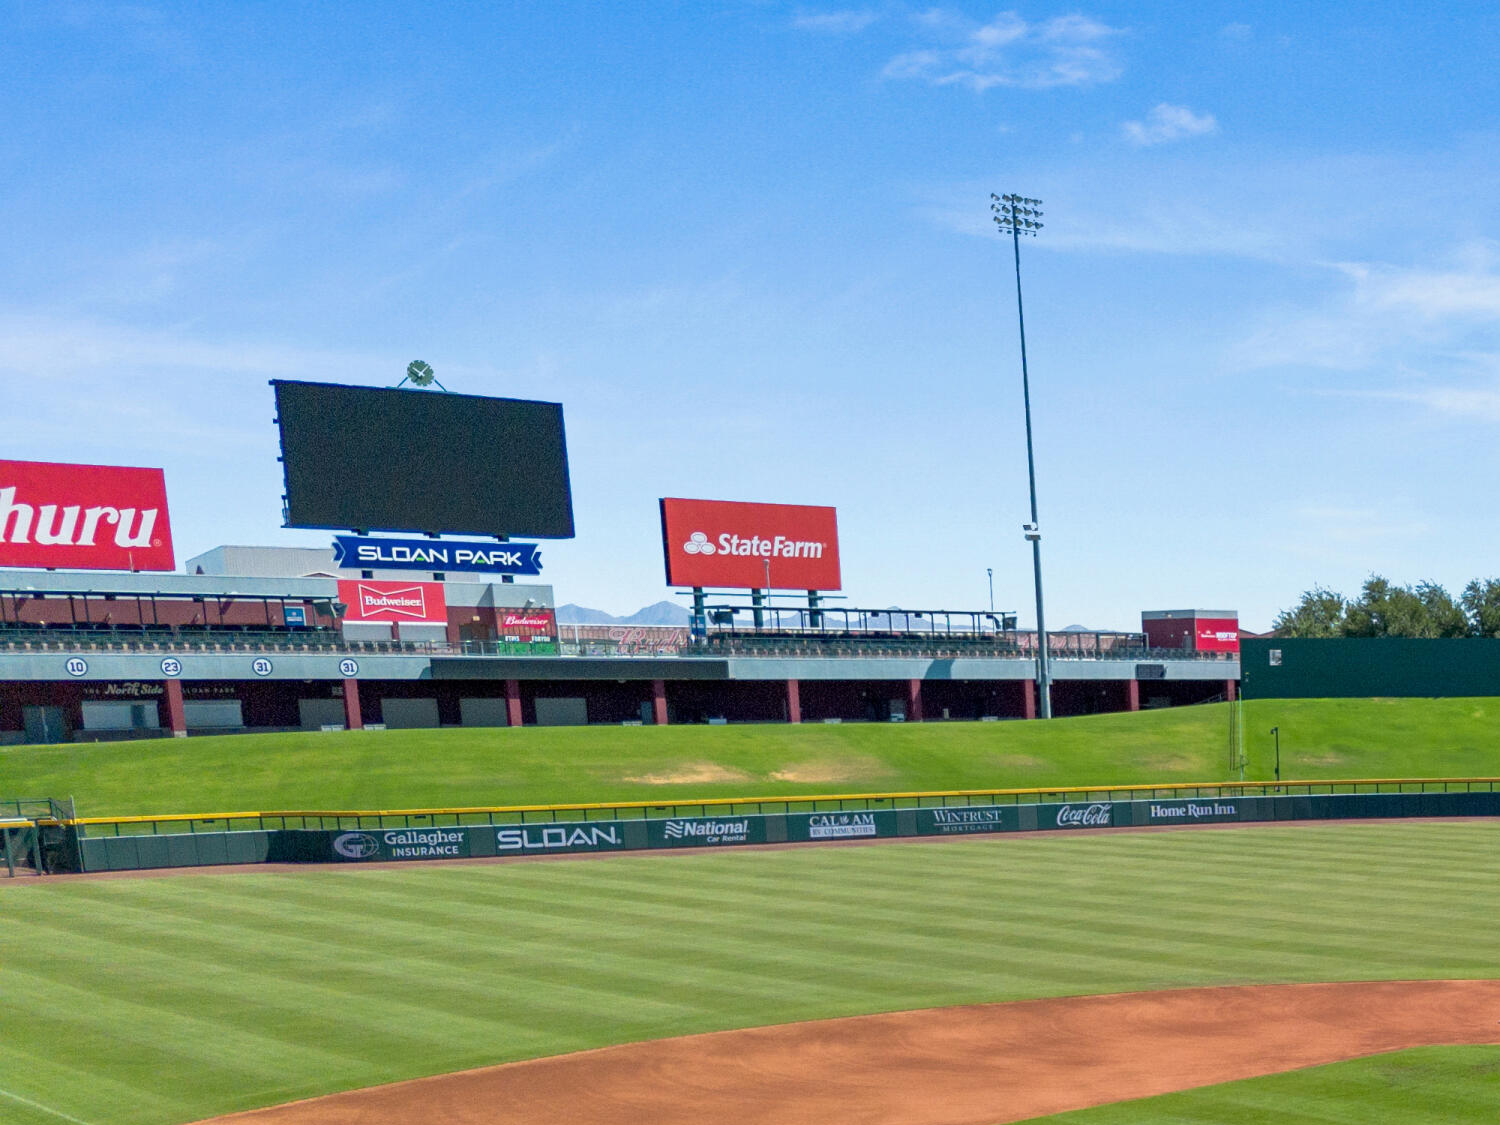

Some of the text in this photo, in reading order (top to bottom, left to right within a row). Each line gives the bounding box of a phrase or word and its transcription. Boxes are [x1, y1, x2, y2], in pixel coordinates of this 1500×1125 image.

[358, 546, 523, 566] SLOAN PARK
[364, 596, 422, 607] Budweiser
[70, 661, 84, 672] 10
[164, 662, 178, 672] 23
[256, 662, 268, 672] 31
[343, 662, 355, 673] 31
[104, 682, 140, 696] North
[140, 684, 164, 695] Side
[1152, 803, 1236, 817] Home Run Inn
[809, 814, 875, 827] CAL AM
[684, 820, 748, 836] National
[384, 830, 465, 846] Gallagher
[497, 826, 617, 849] SLOAN
[392, 845, 459, 856] INSURANCE
